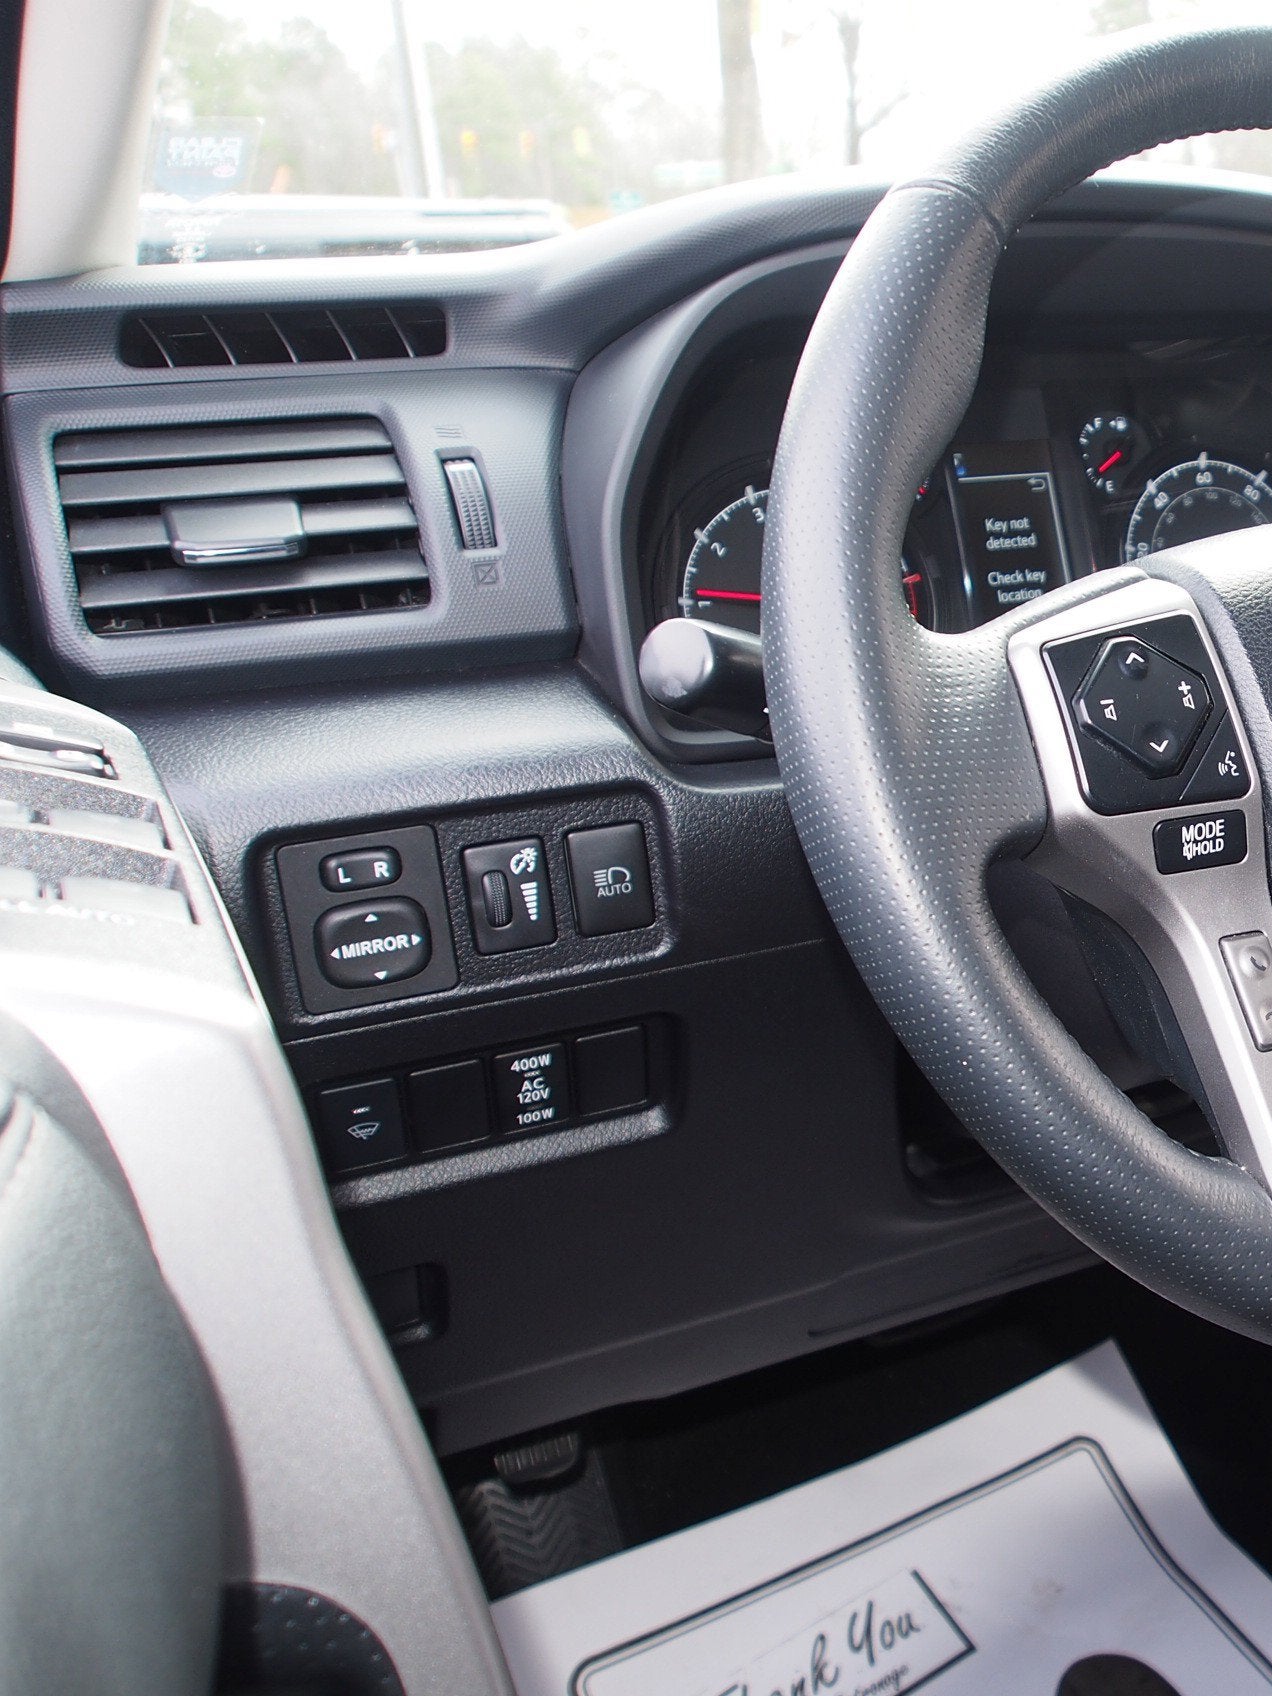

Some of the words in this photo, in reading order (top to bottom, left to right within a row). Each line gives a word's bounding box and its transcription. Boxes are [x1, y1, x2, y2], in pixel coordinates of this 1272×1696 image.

[1093, 416, 1102, 430] F
[1105, 480, 1116, 493] E
[1195, 471, 1214, 486] 60
[1153, 491, 1170, 511] 40
[1243, 484, 1261, 502] 80
[752, 506, 765, 522] 3
[985, 517, 1007, 533] Key
[1009, 516, 1030, 530] not
[710, 541, 726, 557] 2
[985, 532, 1038, 551] detected
[987, 569, 1024, 587] Check
[1024, 568, 1047, 583] key
[997, 588, 1043, 605] location
[1181, 818, 1225, 844] MODE
[1192, 838, 1225, 857] HOLD
[337, 867, 352, 884] L
[373, 861, 390, 878] R
[597, 882, 632, 898] AUTO
[340, 934, 410, 959] MIRROR
[510, 1053, 553, 1073] 400W
[521, 1077, 546, 1093] AC
[516, 1087, 551, 1105] 120V
[516, 1107, 555, 1125] 100W
[847, 1600, 921, 1668] You
